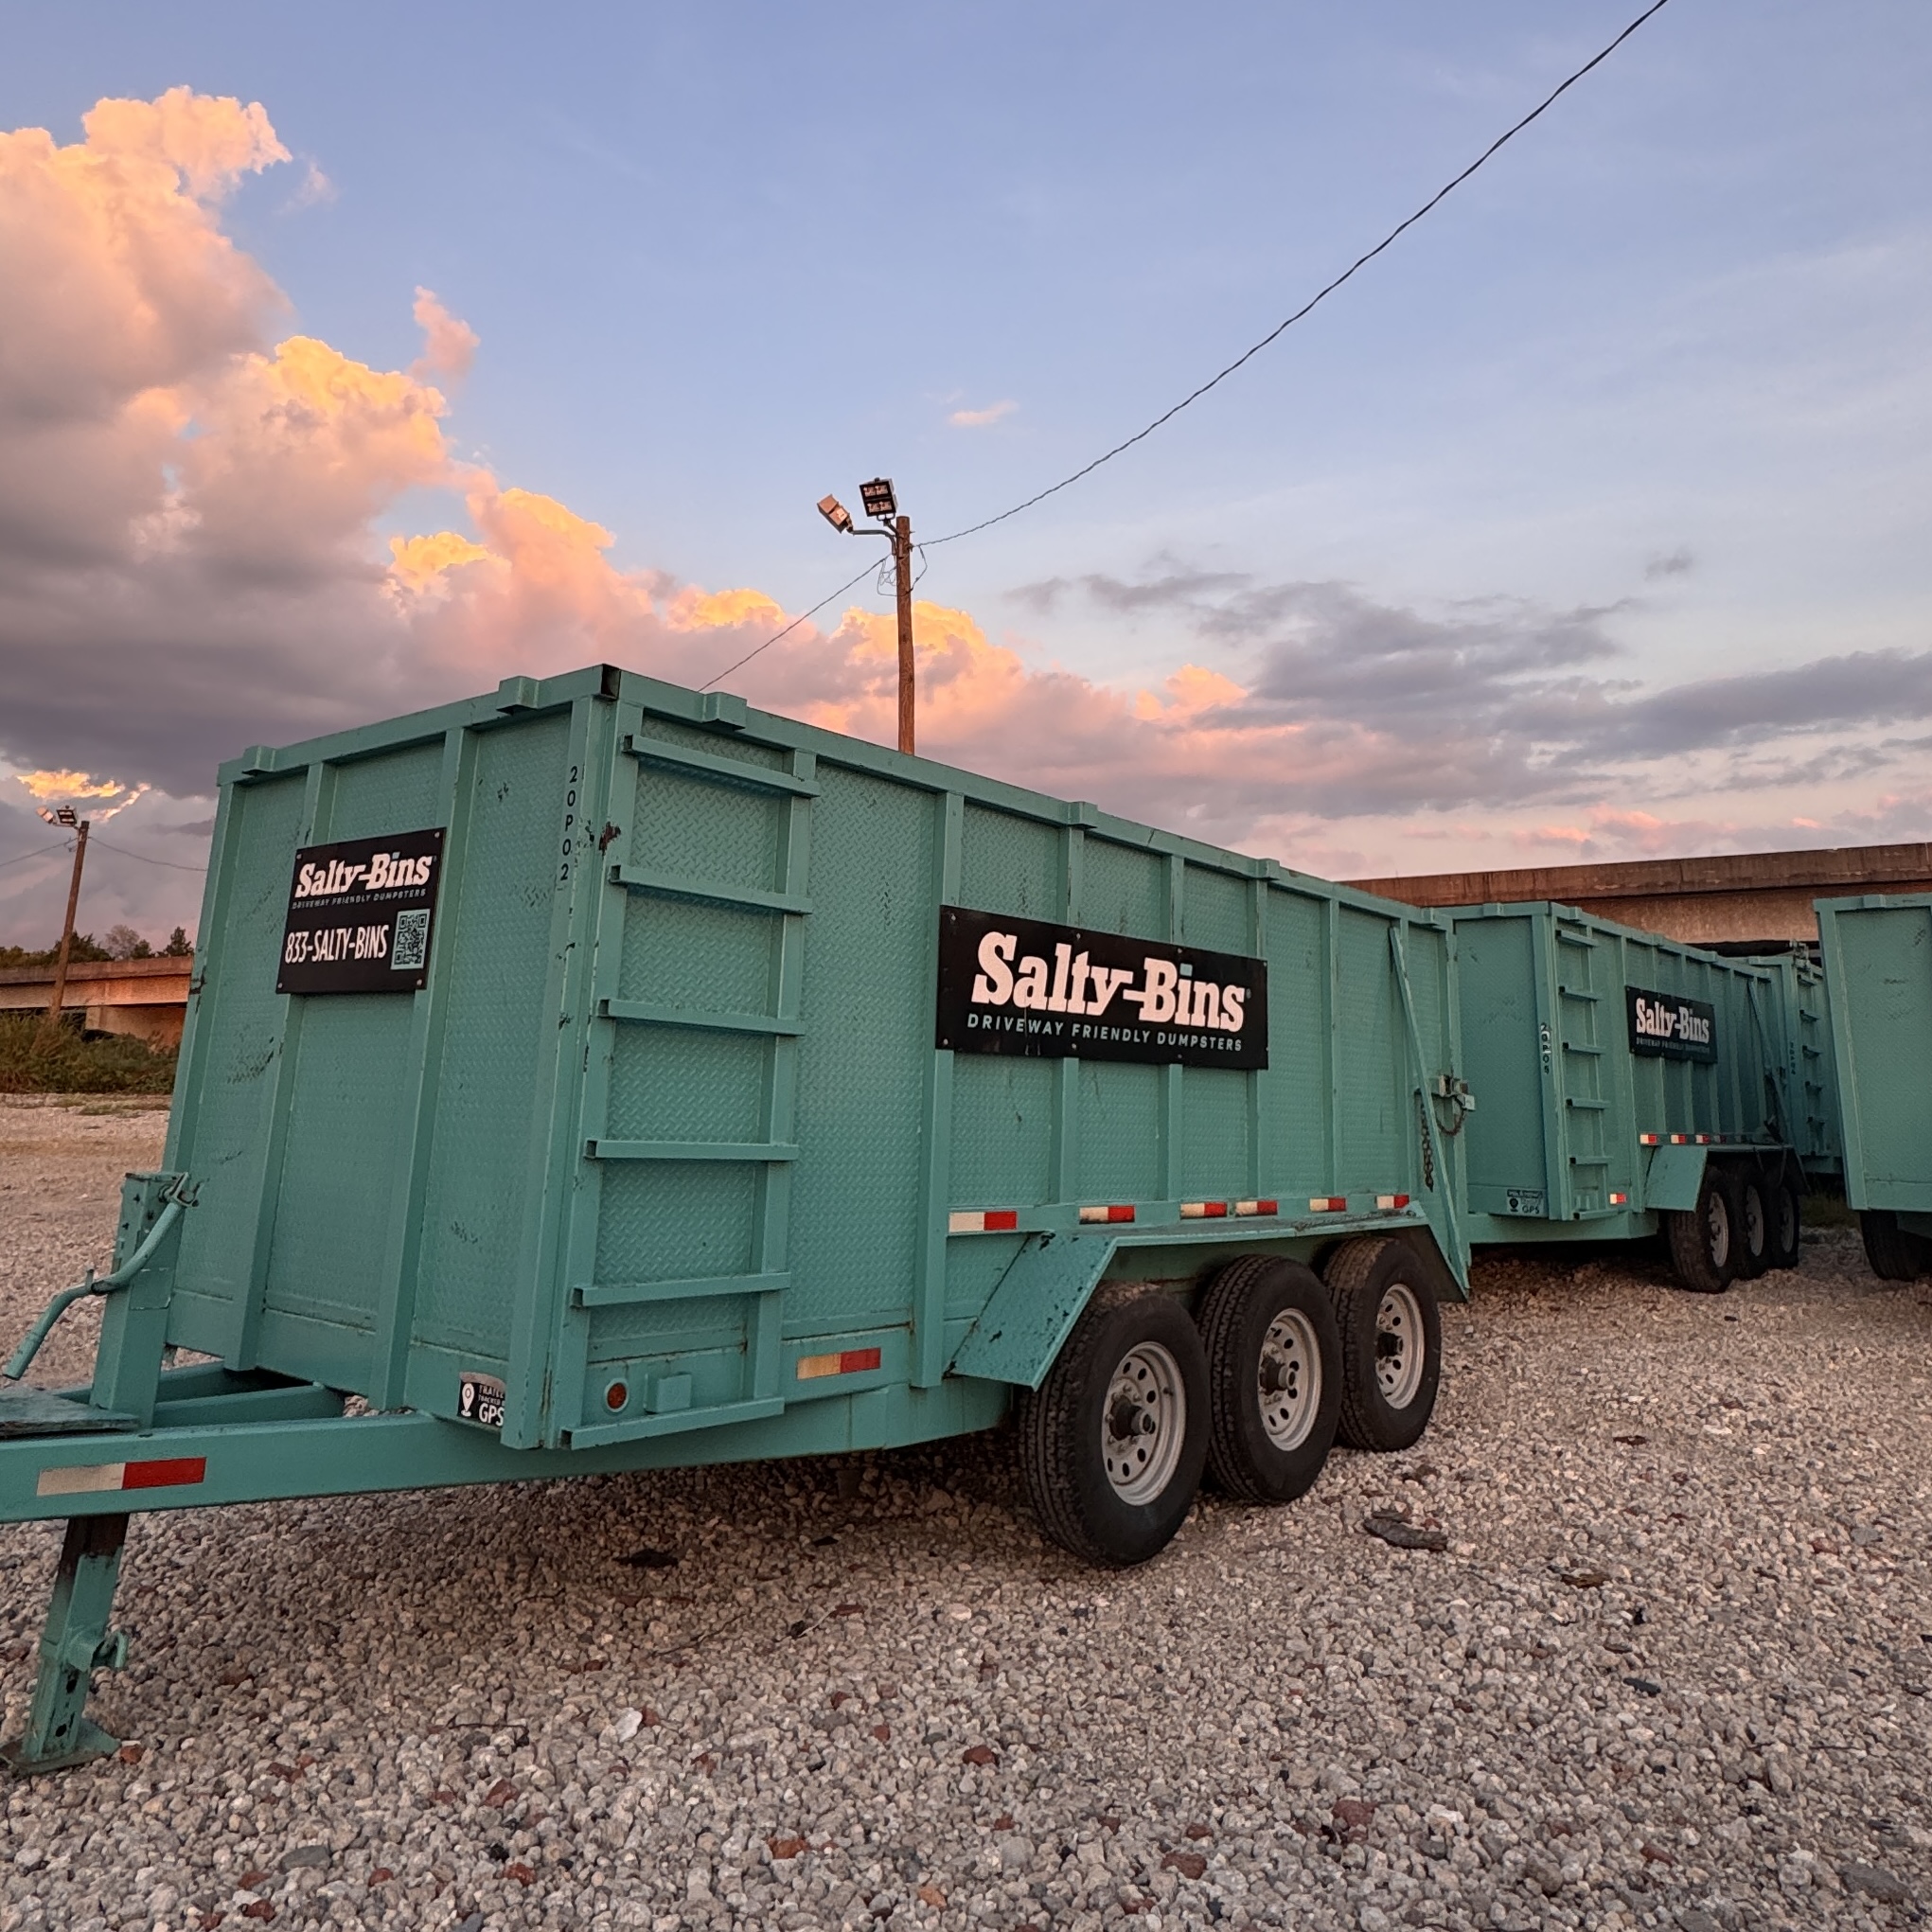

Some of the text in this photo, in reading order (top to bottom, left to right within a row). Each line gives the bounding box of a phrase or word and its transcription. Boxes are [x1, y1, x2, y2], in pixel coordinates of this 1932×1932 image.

[560, 765, 578, 880] 20P02
[294, 852, 433, 898] Salty-Bins
[292, 889, 426, 910] DRIVEWAY FRIENDLY DUMPSTERS
[285, 924, 389, 965] 833-SALTY-BINS
[971, 931, 1246, 1032] Salty-Bins
[967, 1013, 1242, 1052] DRIVEWAY FRIENDLY DUMPSTERS
[1636, 997, 1710, 1044] Salty-Bins
[479, 1384, 504, 1399] TRAILE
[478, 1402, 505, 1427] GPS
